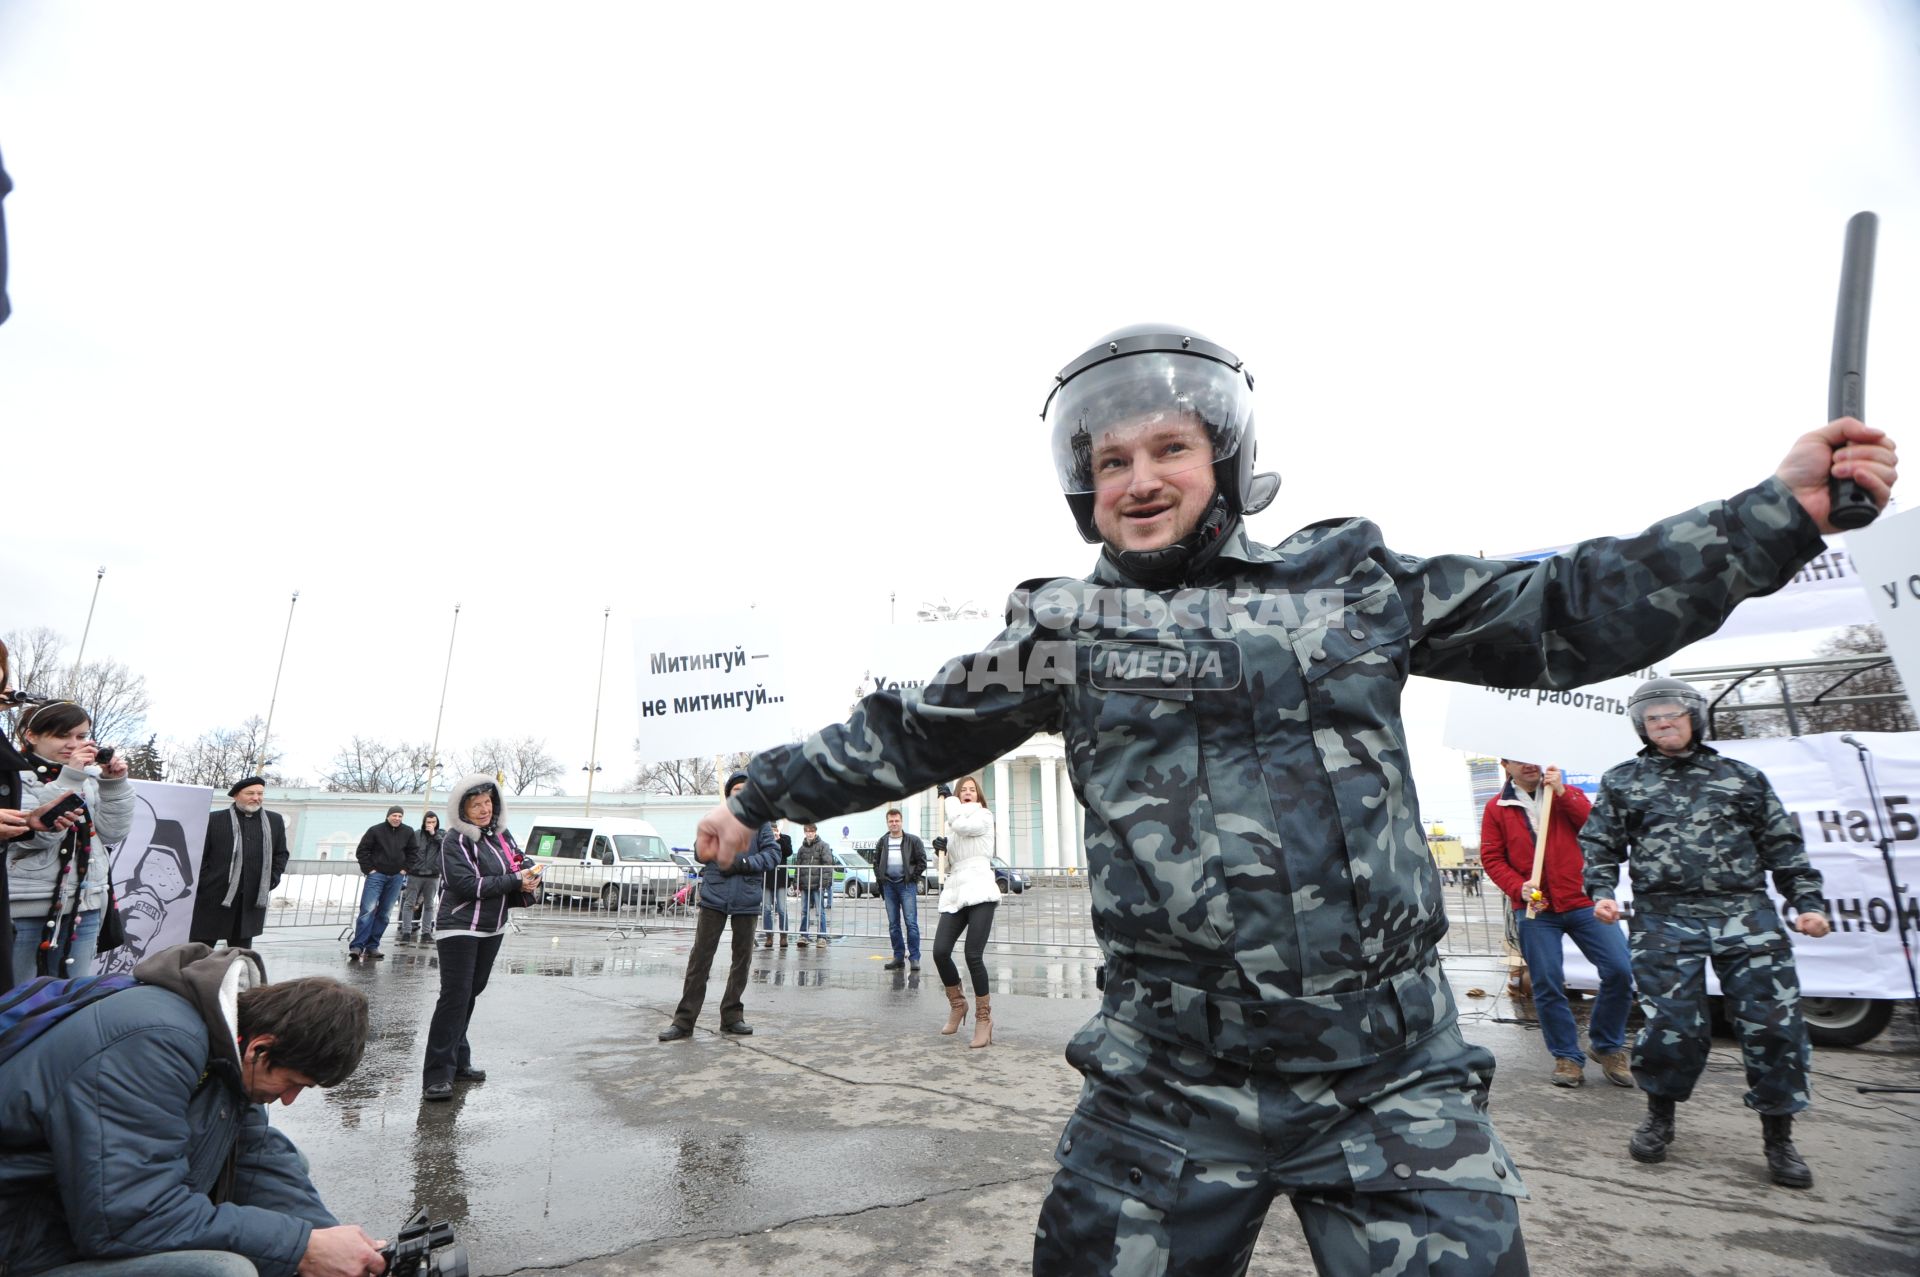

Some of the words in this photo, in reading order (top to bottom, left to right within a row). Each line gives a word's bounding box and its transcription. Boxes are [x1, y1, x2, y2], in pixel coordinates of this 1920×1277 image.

[650, 645, 746, 675] Митингуй
[642, 699, 667, 718] не
[674, 683, 784, 713] митингуй...
[1817, 810, 1875, 843] на
